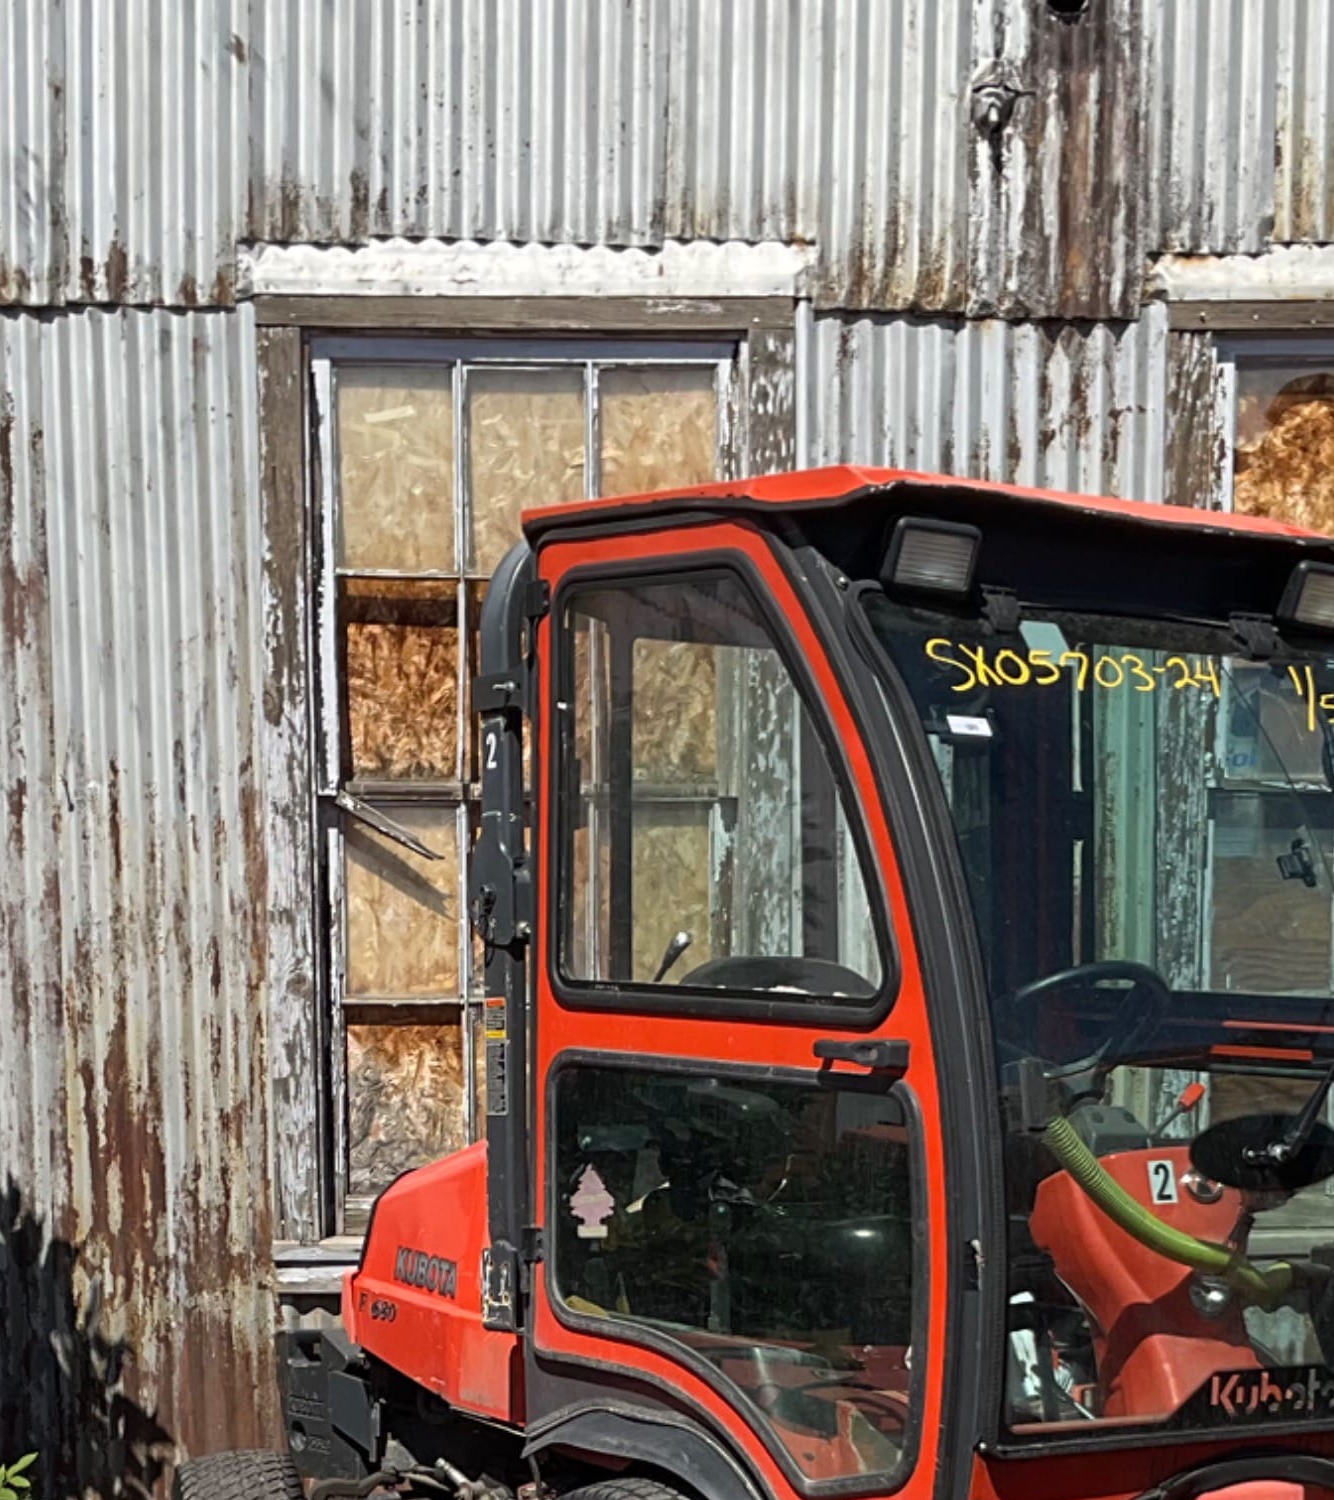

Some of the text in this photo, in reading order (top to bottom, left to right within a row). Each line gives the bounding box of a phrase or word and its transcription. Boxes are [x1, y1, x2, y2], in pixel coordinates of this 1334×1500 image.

[485, 732, 498, 769] 2
[1153, 1162, 1172, 1201] 2
[394, 1245, 458, 1299] KUBOTA
